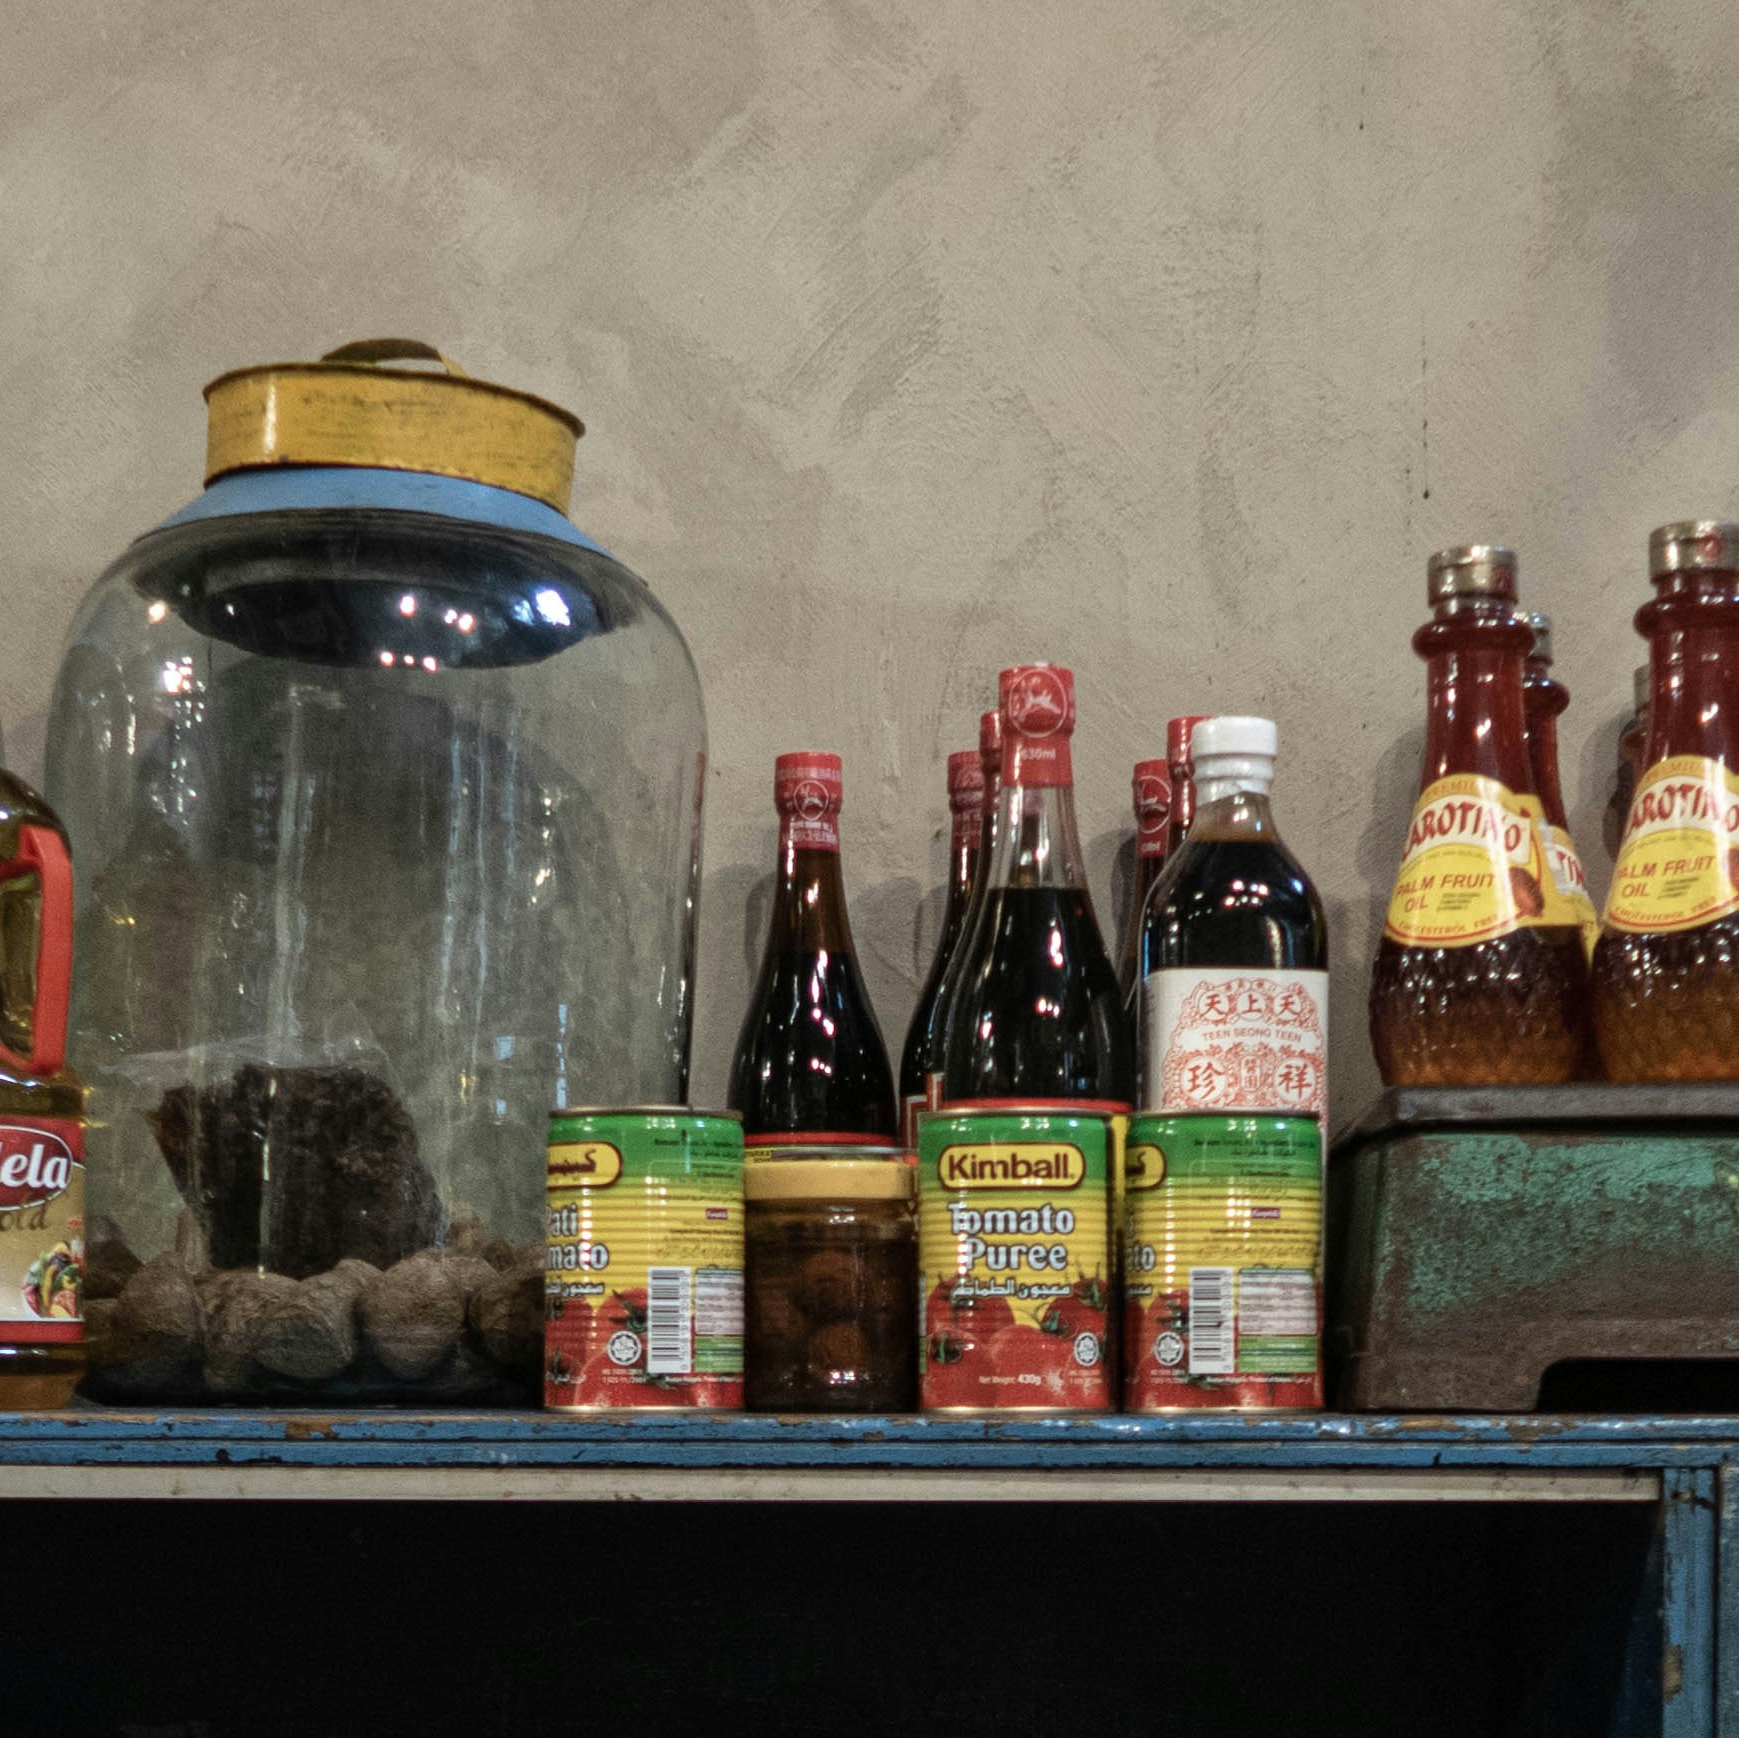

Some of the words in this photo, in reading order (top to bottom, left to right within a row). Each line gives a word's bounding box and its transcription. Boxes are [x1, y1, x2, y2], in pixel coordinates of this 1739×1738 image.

[1662, 855, 1717, 876] FRUIT
[1397, 874, 1435, 897] PALM
[1440, 872, 1496, 890] FRUIT
[1622, 883, 1650, 898] OIL
[1405, 896, 1429, 913] OIL
[1203, 1029, 1230, 1042] TEEN
[1234, 1027, 1272, 1039] SEONG
[1274, 1029, 1302, 1043] TEEN
[948, 1152, 1070, 1180] Kimball
[947, 1201, 1075, 1235] Tomato
[546, 1242, 609, 1270] mato
[963, 1237, 1068, 1271] Puree
